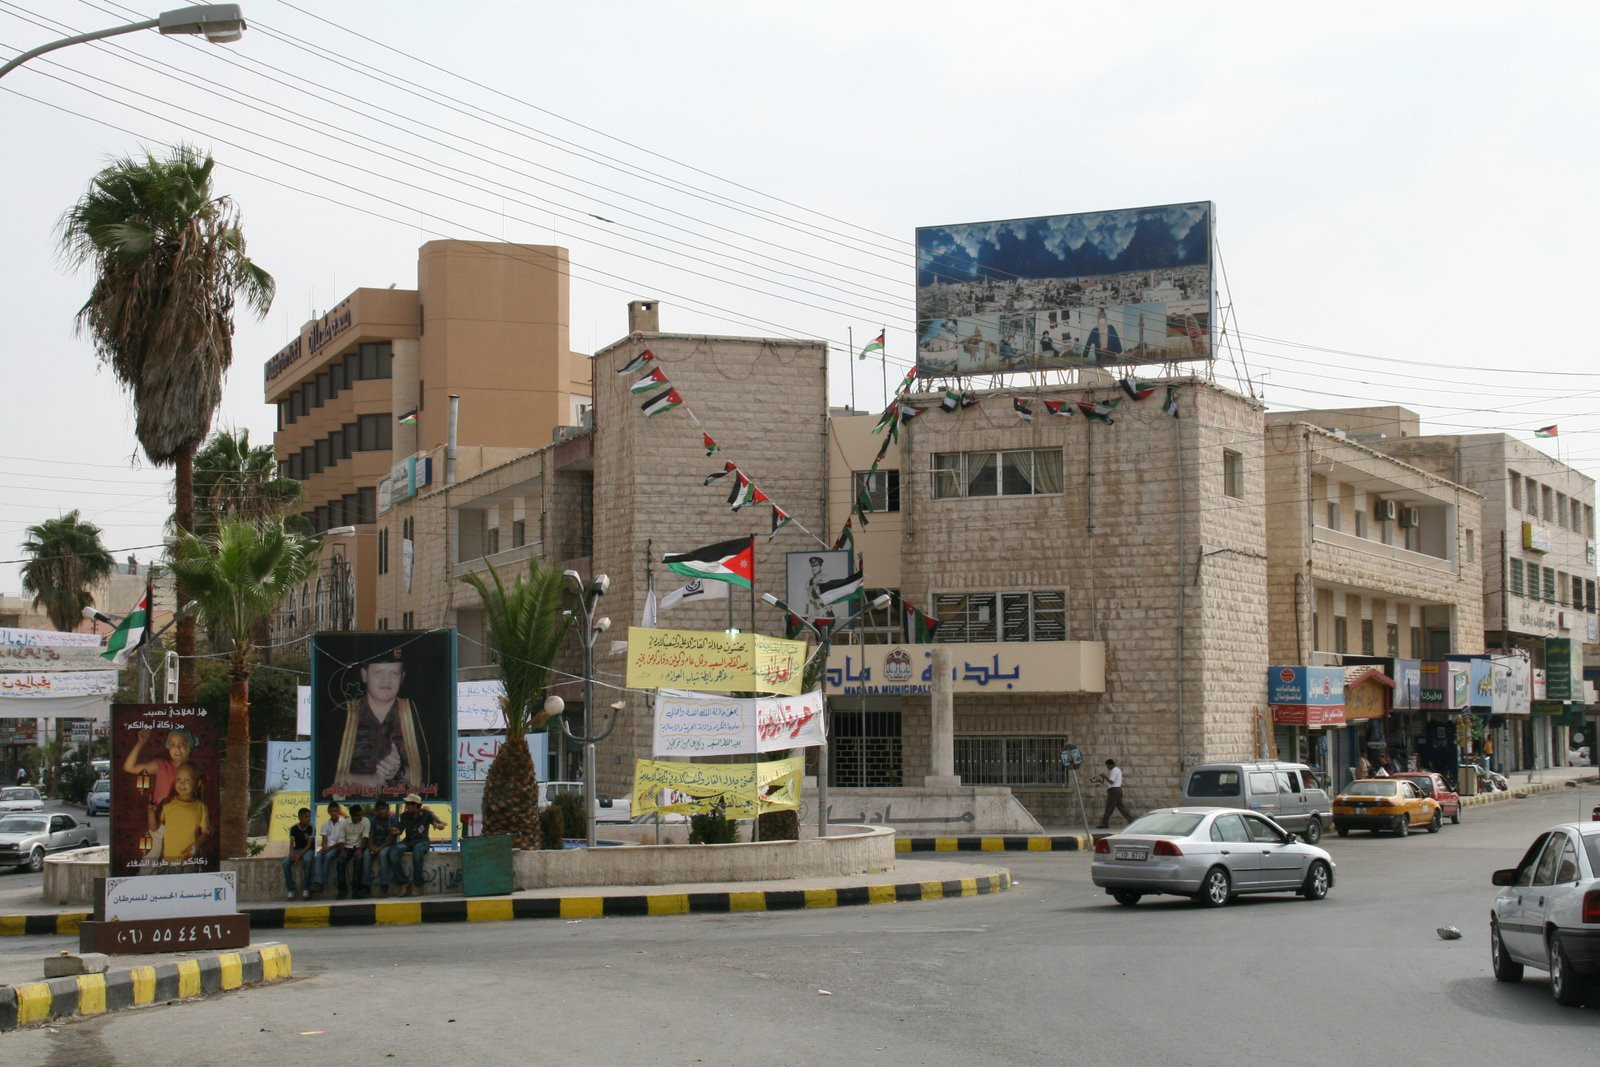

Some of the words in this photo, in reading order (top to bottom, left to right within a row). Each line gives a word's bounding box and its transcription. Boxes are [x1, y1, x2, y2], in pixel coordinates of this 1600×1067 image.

[844, 685, 879, 695] MADABA
[881, 684, 932, 695] MUNICIPALI
[143, 708, 167, 718] نصيب
[169, 706, 195, 718] لعلاجي
[196, 707, 208, 717] هل
[157, 720, 173, 730] زكاة
[175, 722, 185, 730] من
[126, 860, 149, 868] الشفاء
[151, 859, 168, 868] طريق
[183, 857, 208, 866] زكاتكم
[113, 892, 148, 905] للسرطان
[149, 891, 178, 903] الحسين
[179, 888, 212, 899] مؤسسة
[152, 928, 172, 942] ٥٥
[178, 926, 197, 942] ٤٤
[202, 923, 231, 940] ٩٦٠
